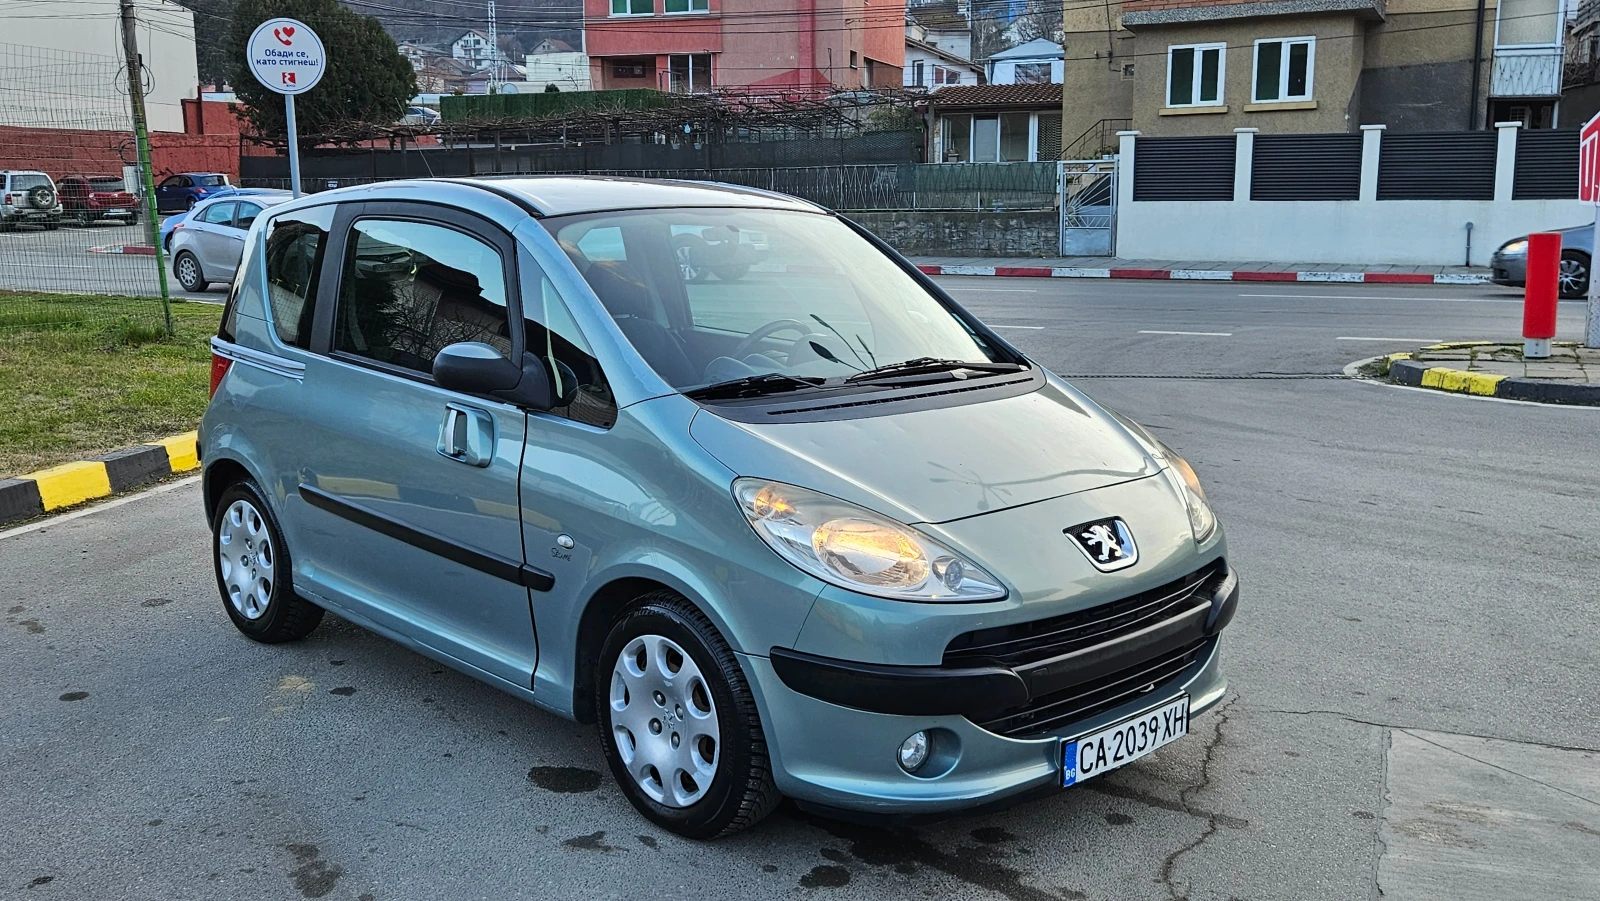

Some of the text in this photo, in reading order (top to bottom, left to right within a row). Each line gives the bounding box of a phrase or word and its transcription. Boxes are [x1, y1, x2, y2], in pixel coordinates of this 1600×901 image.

[264, 48, 309, 59] Обади се,
[279, 58, 319, 66] стигнеш!
[1080, 703, 1185, 774] CA 2039 XH
[1065, 768, 1076, 780] BG
